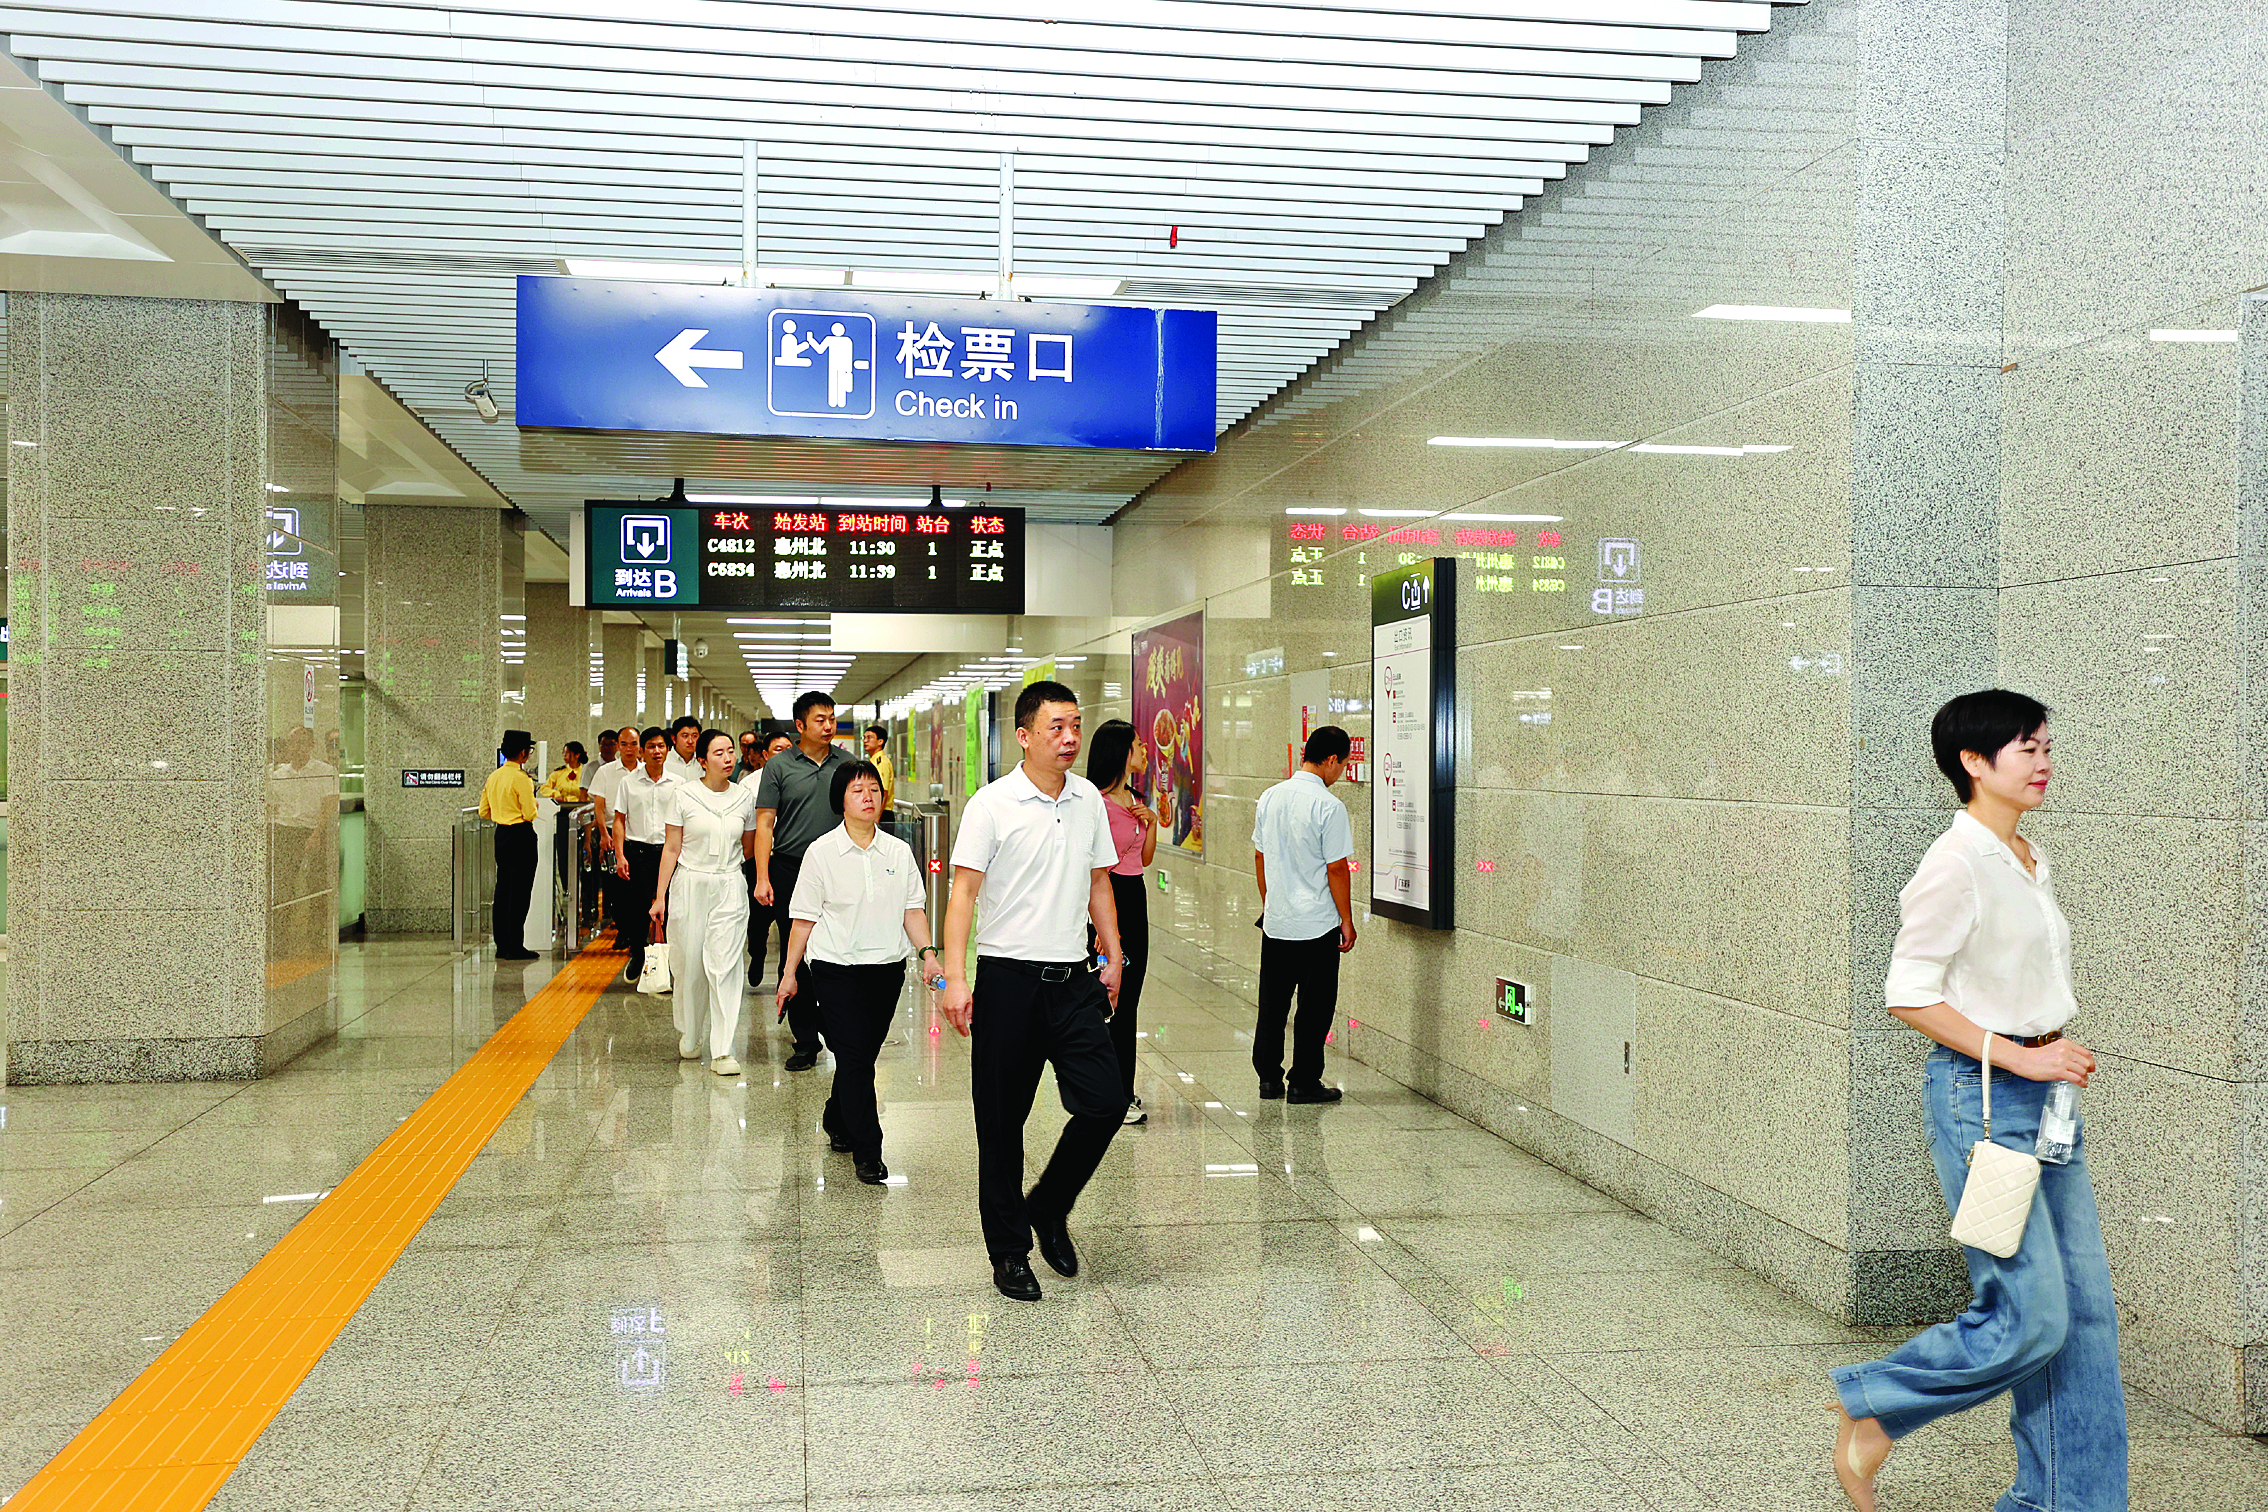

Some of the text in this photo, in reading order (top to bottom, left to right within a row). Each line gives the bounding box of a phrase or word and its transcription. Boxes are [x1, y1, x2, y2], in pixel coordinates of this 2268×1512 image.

[895, 319, 1073, 383] 检票口
[894, 389, 1018, 420] Check in
[714, 511, 1005, 534] 车次 始发站 到站时间 站台 状态
[707, 536, 1004, 559] C4812 惠州北 11:30 1 正点
[614, 568, 652, 588] 到达
[707, 560, 1004, 582] C6834 惠州北 11:39 1 正点
[615, 587, 652, 598] Arrivals
[655, 569, 678, 599] B
[1401, 580, 1411, 610] C
